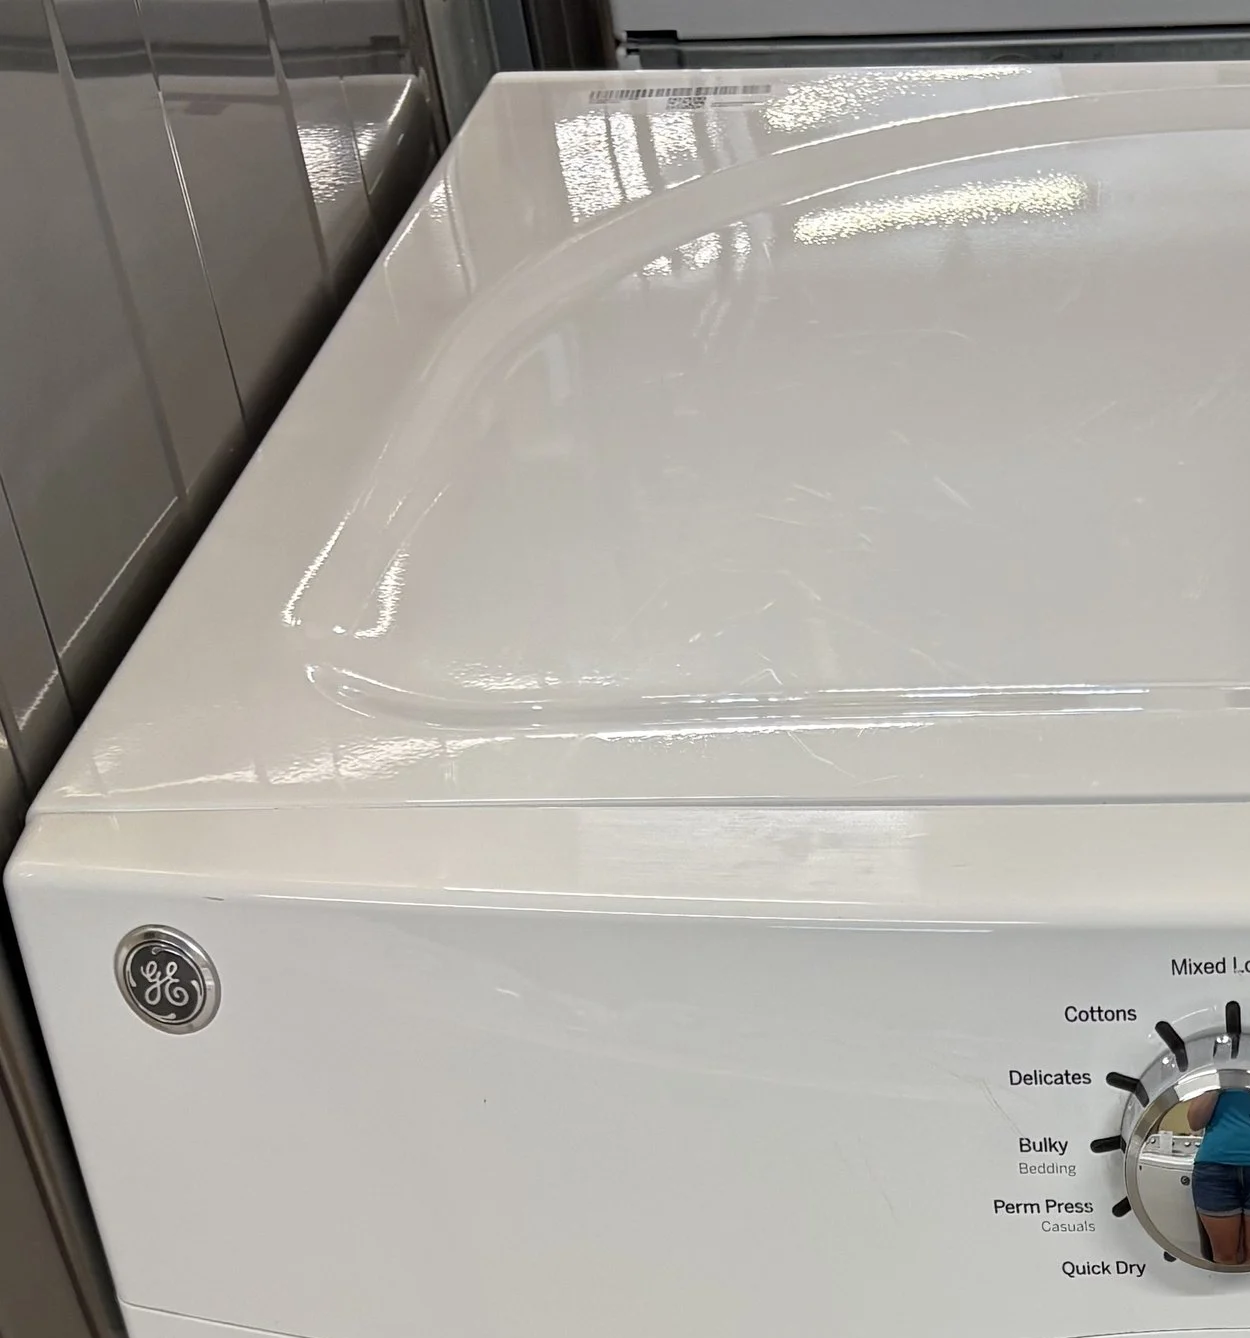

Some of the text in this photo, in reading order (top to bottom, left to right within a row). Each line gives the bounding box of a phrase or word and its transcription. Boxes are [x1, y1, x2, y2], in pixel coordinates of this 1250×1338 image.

[1171, 956, 1226, 977] Mixed
[141, 960, 189, 1006] GE
[1064, 1004, 1137, 1023] Cottons
[1008, 1068, 1092, 1086] Delicates
[1019, 1137, 1068, 1156] Bulky
[1019, 1161, 1076, 1177] Bedding
[994, 1198, 1094, 1216] Perm Press
[1041, 1220, 1095, 1234] Casuals
[1061, 1260, 1146, 1279] Quick Dry
